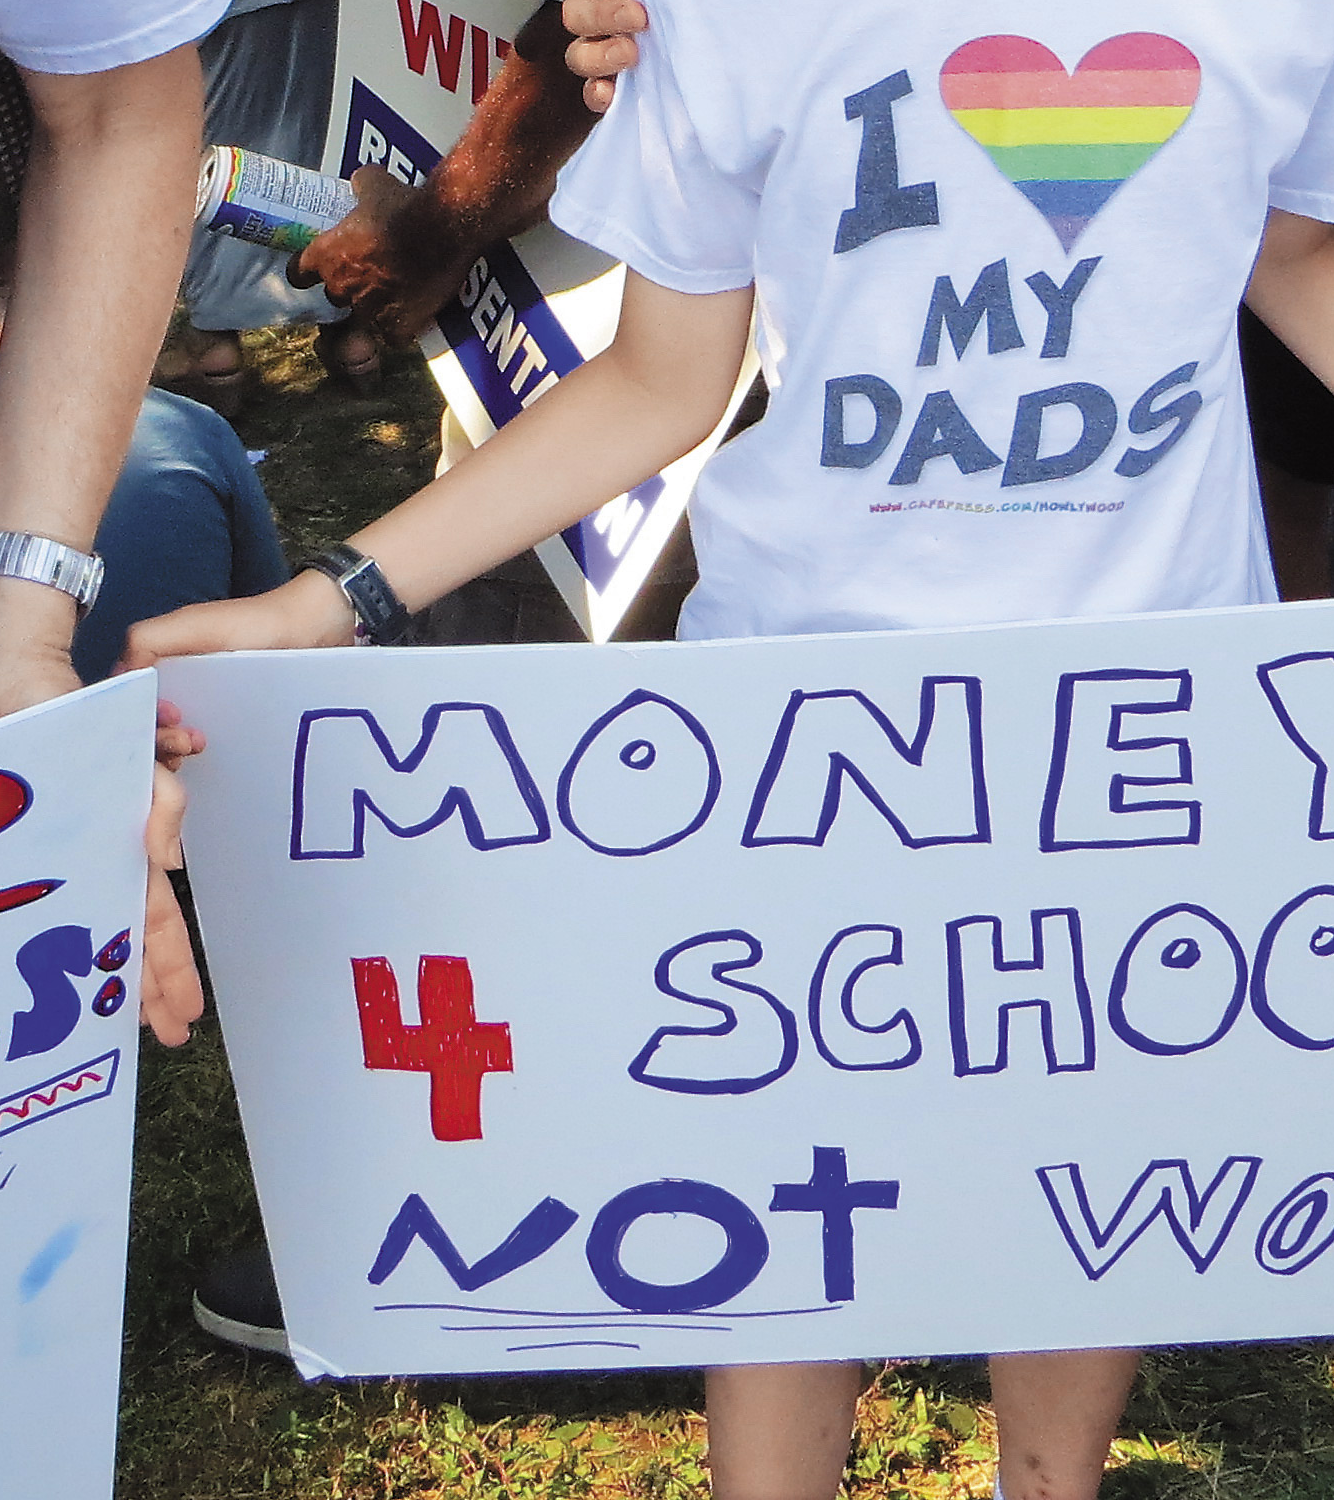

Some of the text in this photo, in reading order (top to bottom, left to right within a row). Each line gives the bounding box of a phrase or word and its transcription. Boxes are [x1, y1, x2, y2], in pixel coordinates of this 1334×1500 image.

[833, 68, 941, 256] I
[915, 254, 1103, 368] MY
[819, 360, 1204, 489] DADS
[350, 953, 514, 1141] 4
